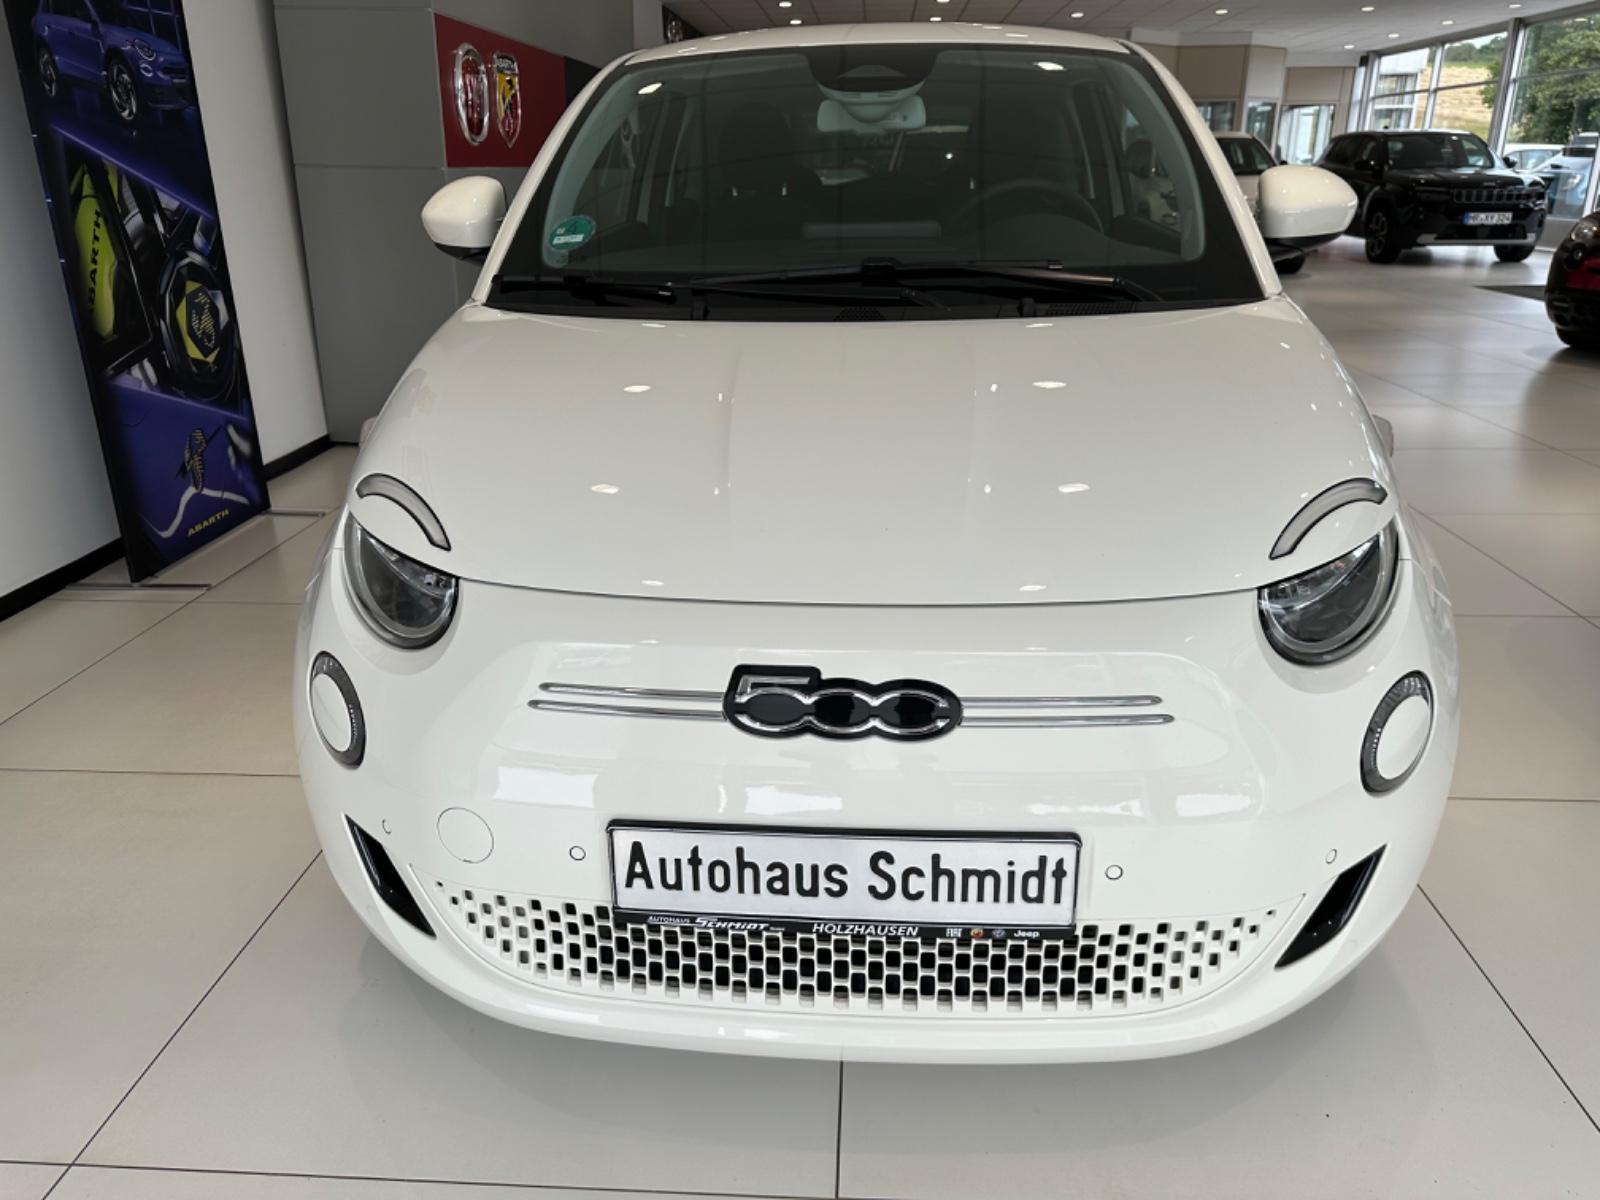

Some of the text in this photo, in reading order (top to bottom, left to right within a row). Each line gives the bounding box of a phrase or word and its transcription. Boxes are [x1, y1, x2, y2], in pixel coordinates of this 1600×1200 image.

[187, 509, 230, 537] ABARTH
[733, 673, 952, 736] 500
[624, 840, 1068, 904] Autohaus Schmidt
[812, 923, 919, 936] HOLZHAUSEN
[1013, 930, 1040, 939] Jeep
